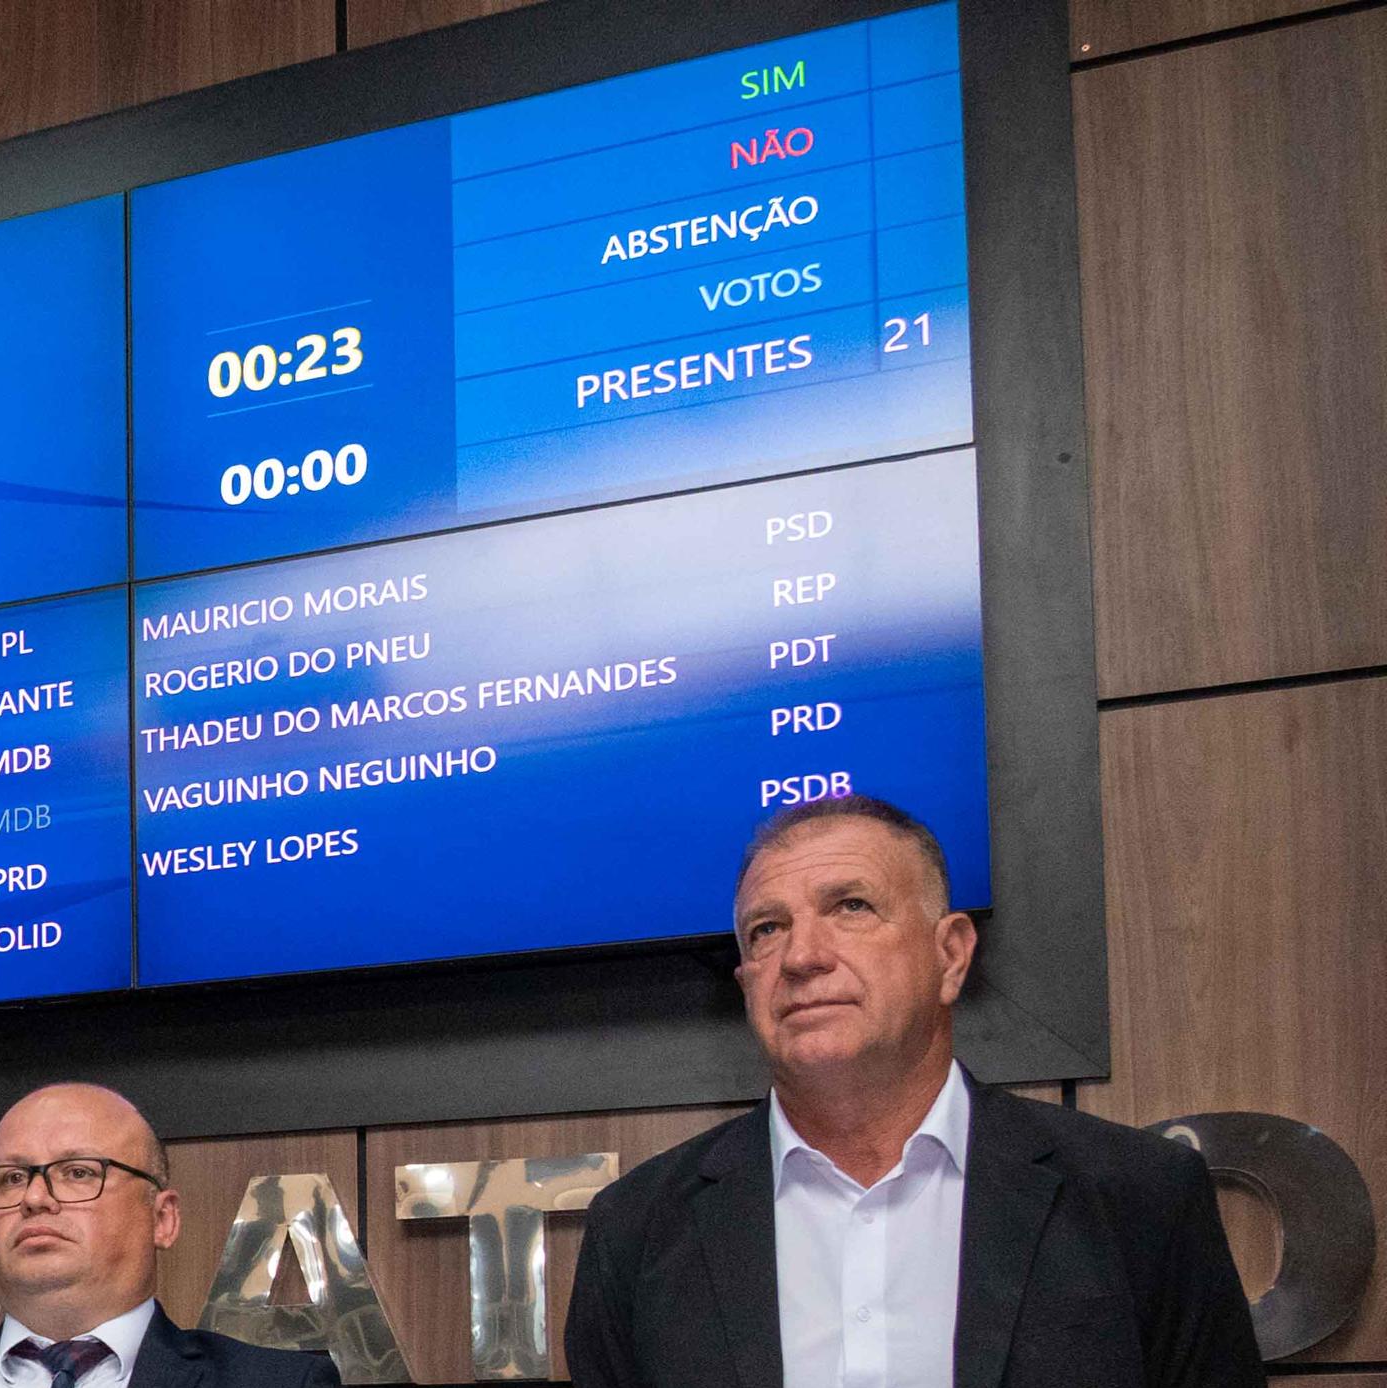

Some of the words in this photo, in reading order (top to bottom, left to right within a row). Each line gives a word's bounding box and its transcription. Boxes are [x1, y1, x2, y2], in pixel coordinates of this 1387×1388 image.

[741, 62, 806, 100] SIM
[731, 127, 814, 170] NÃO
[600, 195, 819, 265] ABSTENÇÃO
[698, 262, 822, 312] VOTOS
[207, 326, 364, 398] 00:23
[576, 334, 814, 409] PRESENTES
[883, 312, 932, 353] 21
[220, 443, 368, 506] 00:00
[766, 510, 833, 545] PSD
[143, 599, 294, 642] MAURICIO
[304, 573, 428, 617] MORAIS
[773, 572, 837, 607] REP
[1, 629, 34, 657] PL
[145, 655, 279, 698] ROGERIO
[288, 647, 336, 678] DO
[346, 630, 431, 669] PNEU
[769, 633, 837, 670] PDT
[140, 714, 263, 754] THADEU
[273, 707, 321, 737] DO
[331, 685, 469, 729] MARCOS
[478, 656, 677, 709] FERNANDES
[771, 701, 842, 736] PRD
[143, 769, 309, 813] VAGUINHO
[319, 745, 497, 792] NEGUINHO
[761, 771, 852, 808] PSDB
[141, 840, 257, 877] WESLEY
[266, 828, 359, 864] LOPES
